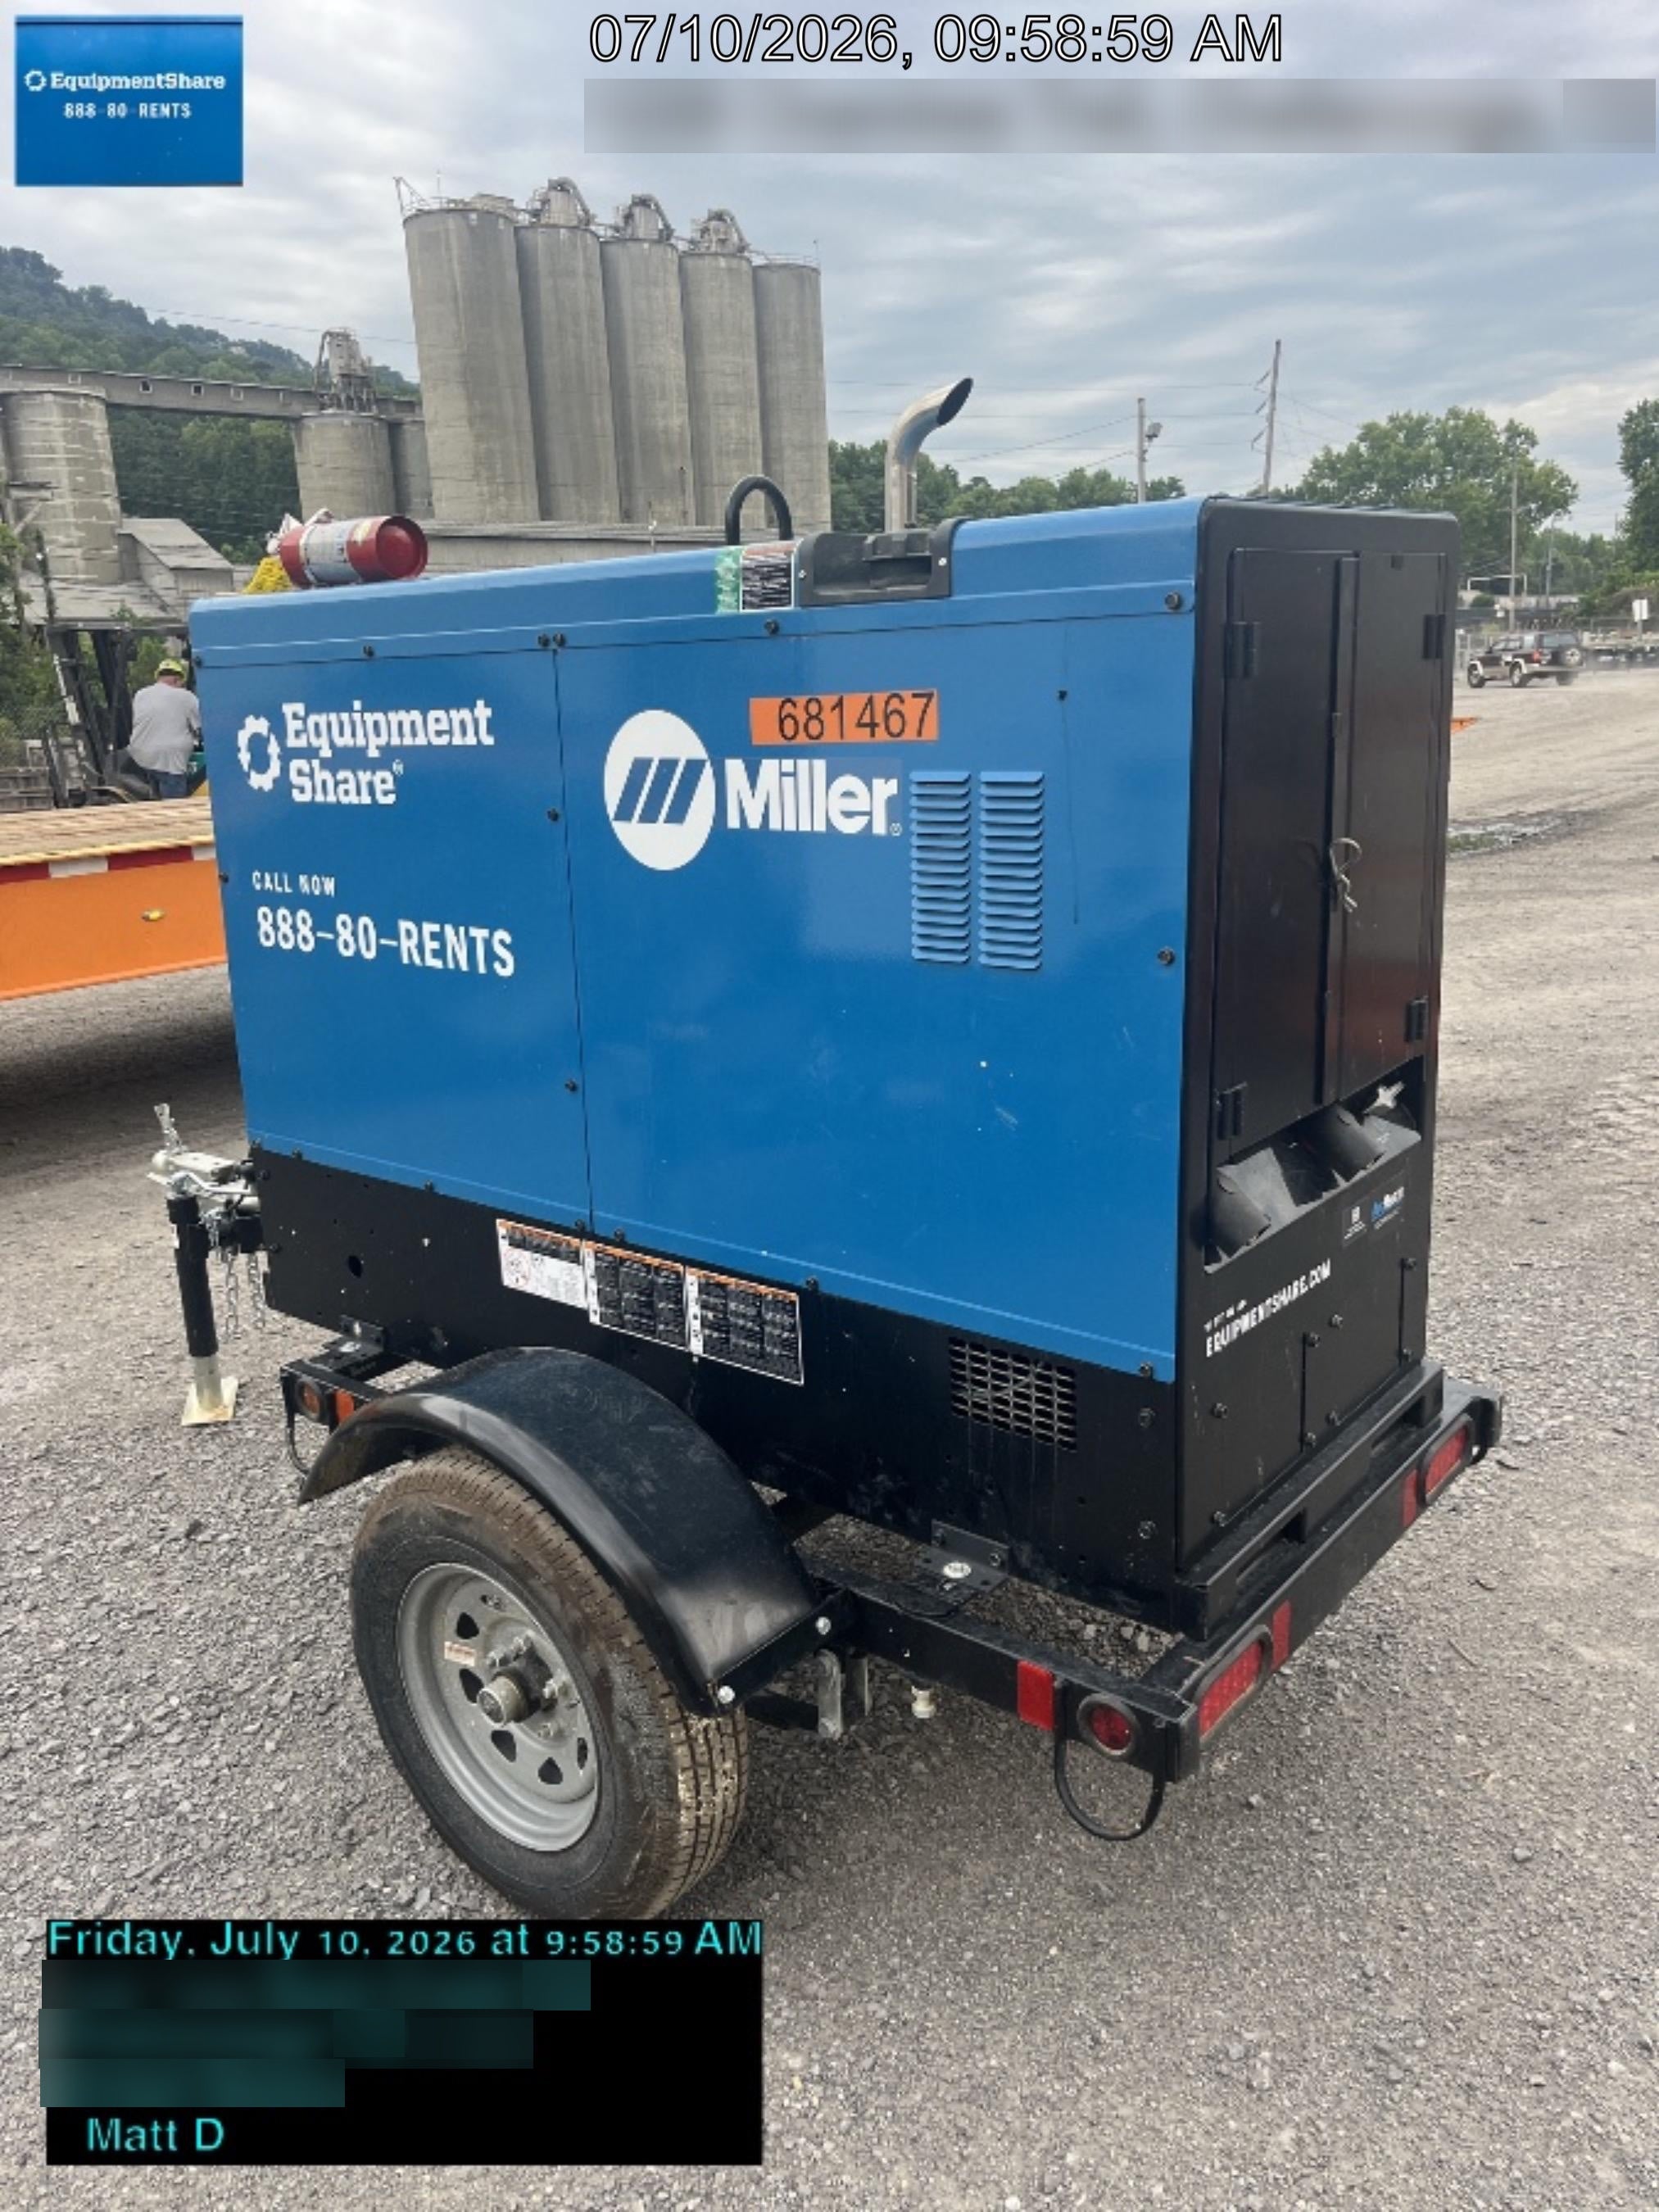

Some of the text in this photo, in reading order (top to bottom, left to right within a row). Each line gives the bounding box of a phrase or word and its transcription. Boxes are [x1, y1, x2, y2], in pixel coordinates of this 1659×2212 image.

[282, 700, 495, 758] Equipment
[778, 691, 936, 742] 681467
[252, 871, 336, 897] CALL NOW
[256, 906, 515, 977] 888-80-RENTS
